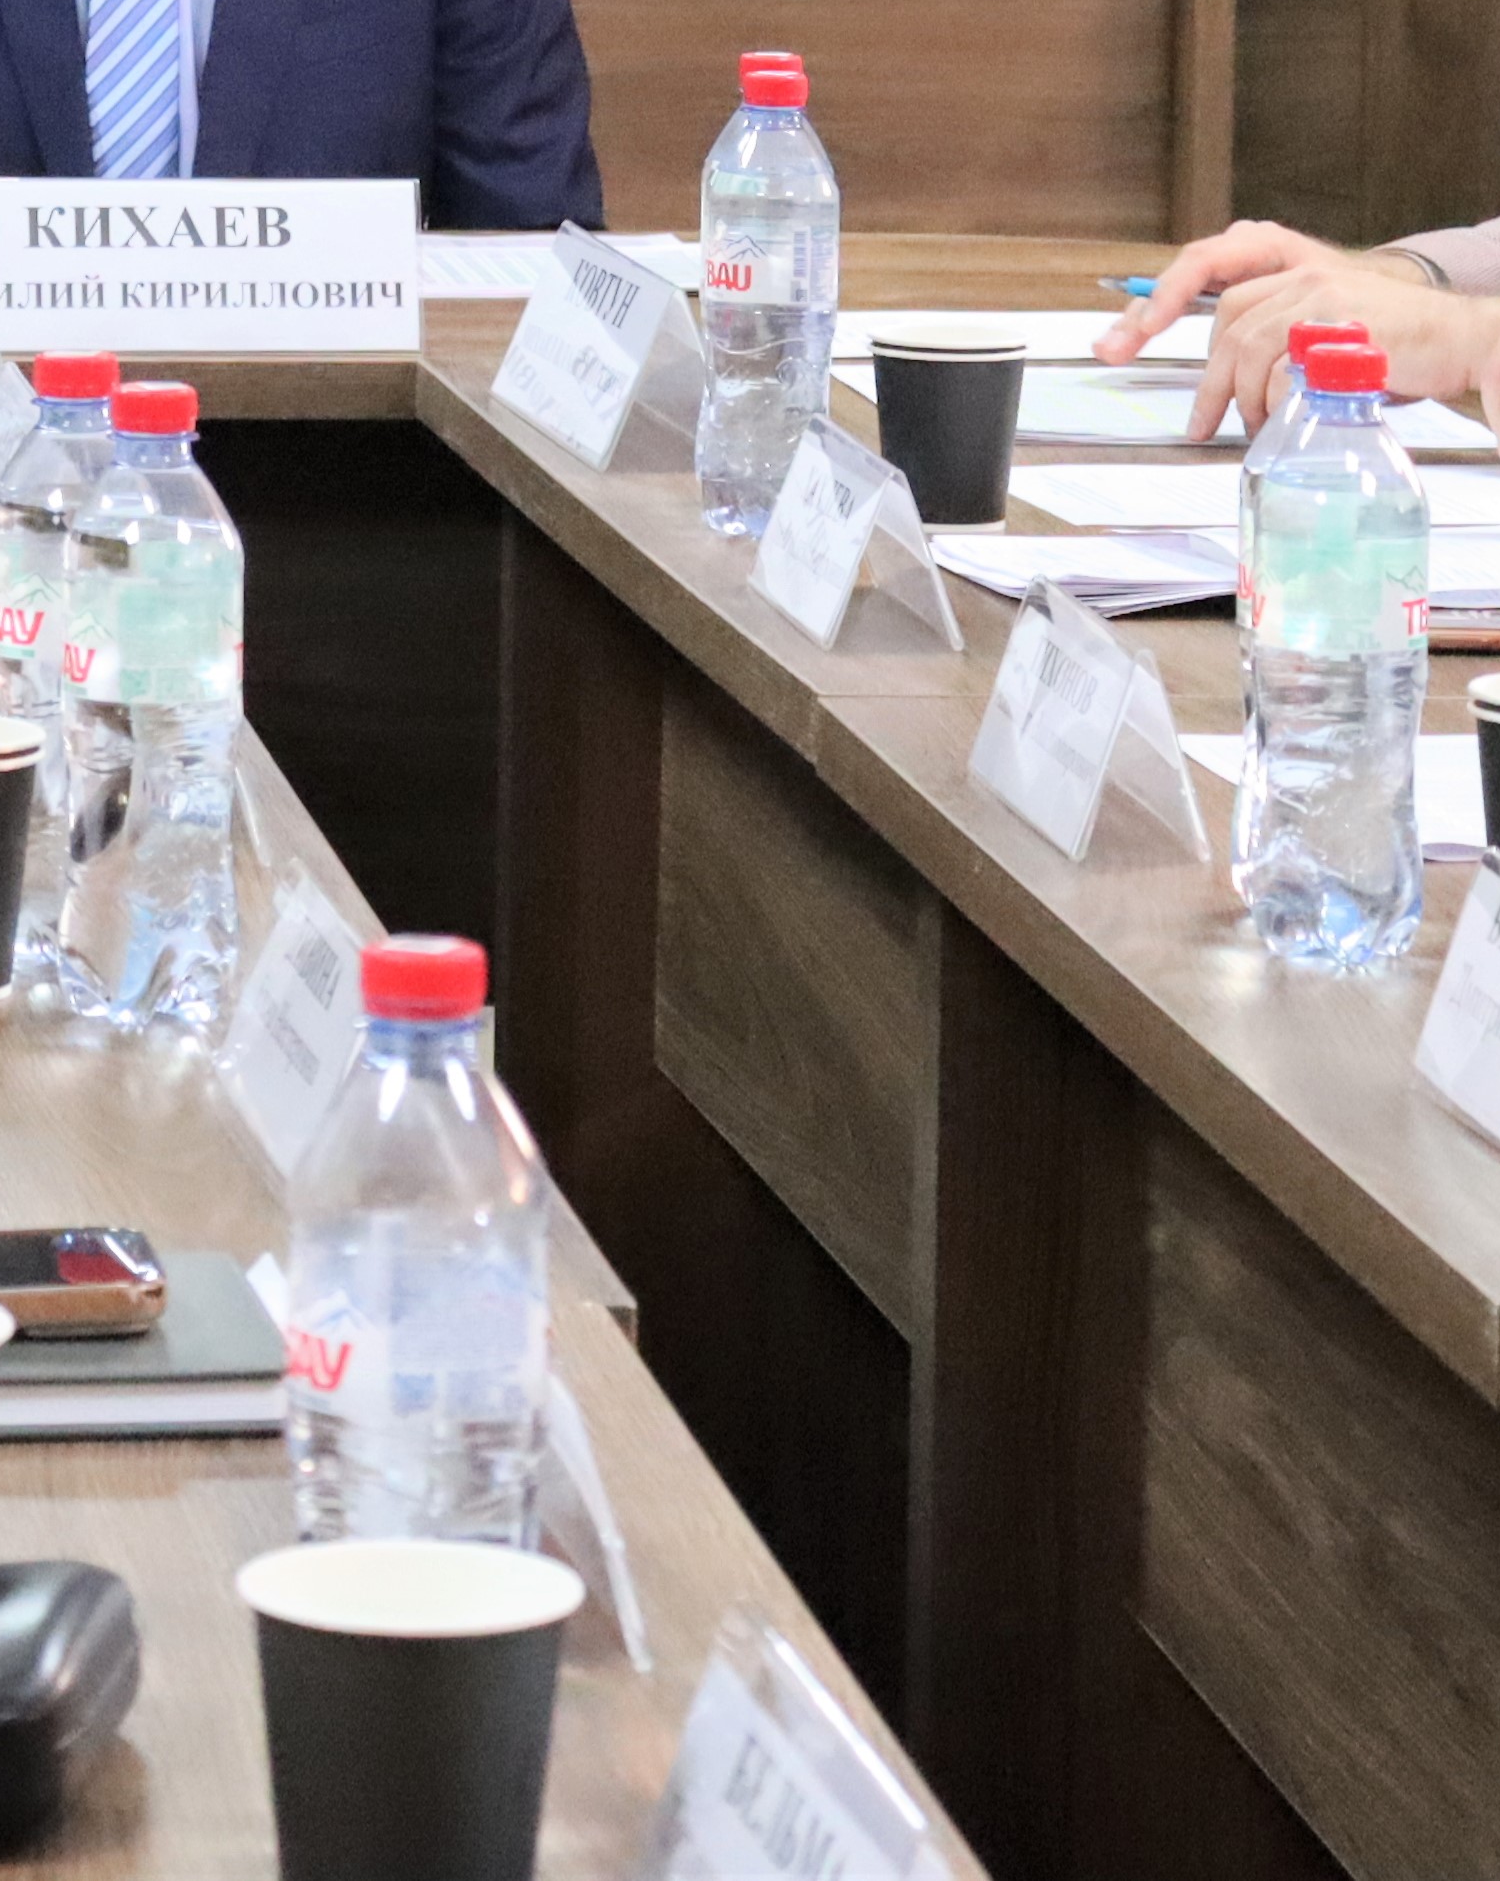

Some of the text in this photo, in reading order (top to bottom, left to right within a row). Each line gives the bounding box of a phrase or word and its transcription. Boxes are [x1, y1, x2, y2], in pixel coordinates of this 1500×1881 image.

[24, 206, 293, 249] КИХАЕВ
[706, 259, 752, 292] BAU
[120, 280, 405, 309] КИРИЛЛОВИЧ
